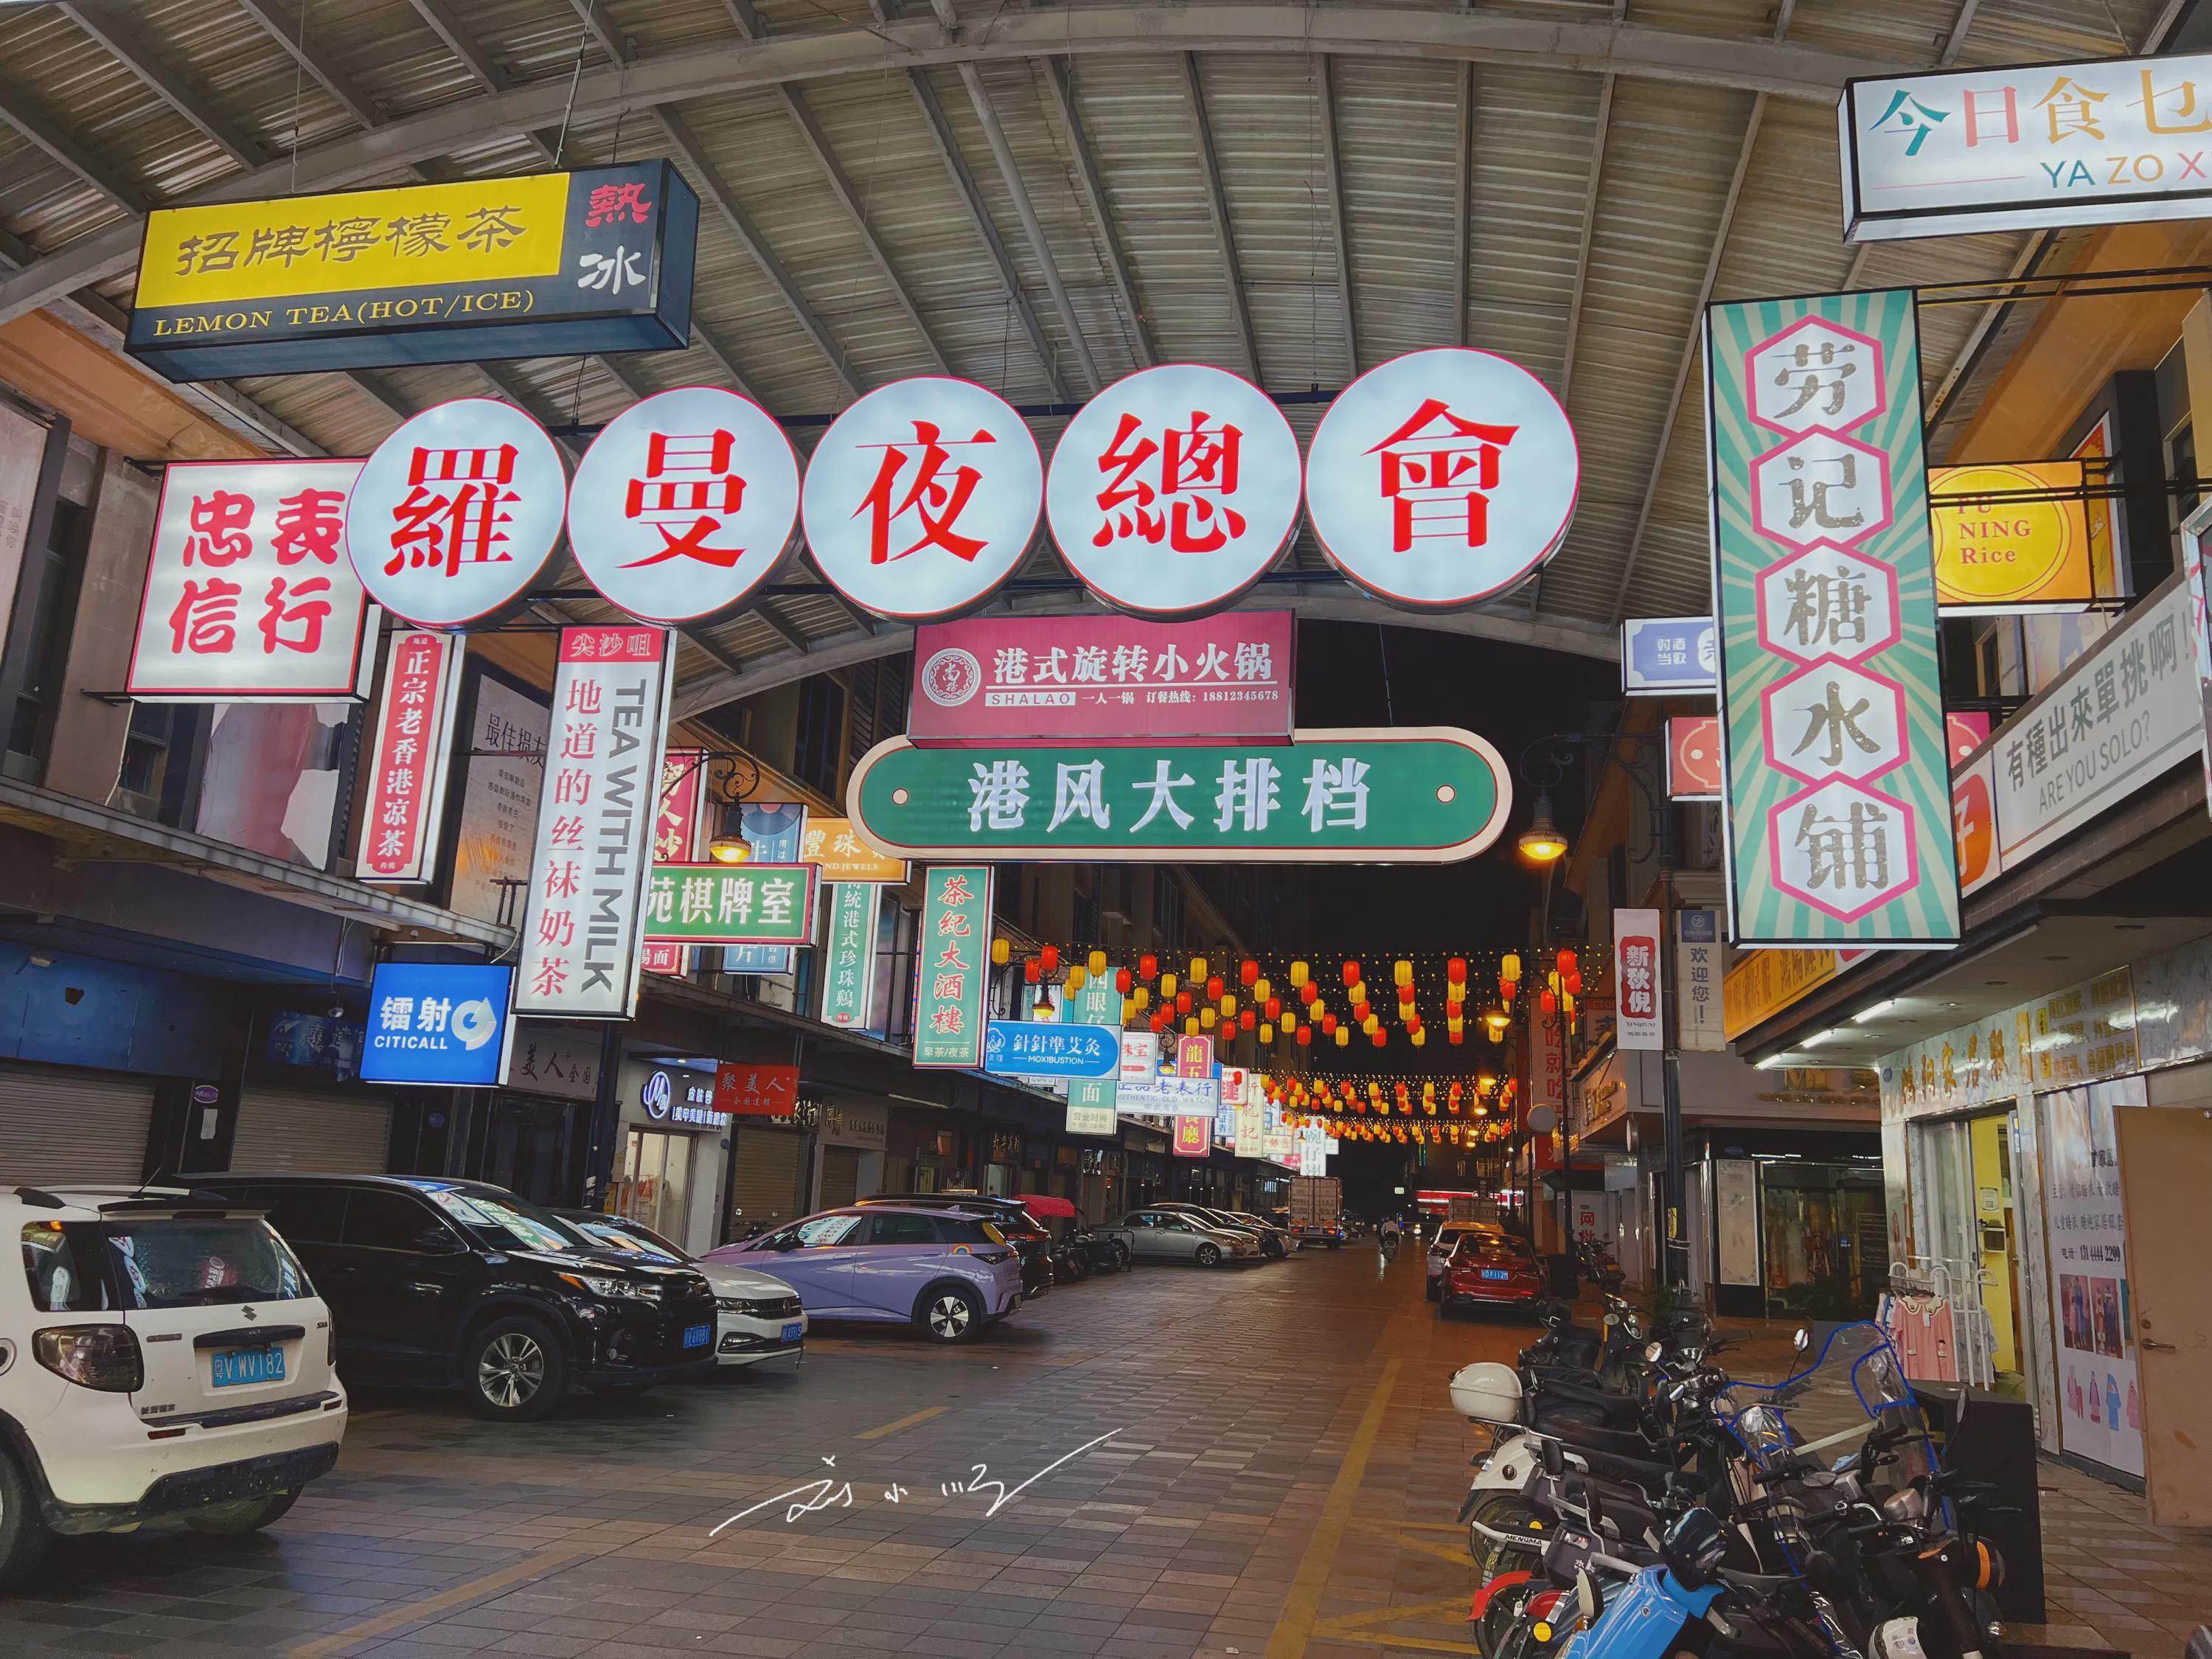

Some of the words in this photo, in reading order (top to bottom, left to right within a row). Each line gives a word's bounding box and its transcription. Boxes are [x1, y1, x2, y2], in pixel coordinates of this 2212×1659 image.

[1869, 69, 2212, 156] 今日食乜
[2177, 150, 2212, 181] X
[174, 206, 528, 277] 招牌檸檬茶
[153, 310, 272, 336] LEMON
[286, 290, 535, 325] TEA(HOT/ICE)
[383, 397, 1522, 577] 羅曼夜總會
[1958, 519, 2031, 540] NING
[1960, 546, 2017, 565] Rice
[569, 632, 652, 658] 尖沙咀
[993, 641, 1272, 685] 港式旋转小火锅
[608, 678, 647, 759] TEA
[991, 693, 1071, 706] SHALAO
[1082, 691, 1135, 705] 一人一锅
[377, 649, 432, 858] 正宗老香港凉茶
[2039, 779, 2065, 814] ARE
[2065, 757, 2097, 795] YOU
[2100, 709, 2151, 776] SOLO?
[967, 757, 1371, 833] 港风大排档
[529, 678, 602, 998] 地道的丝袜奶茶
[597, 764, 638, 877] WITH
[647, 876, 795, 925] 苑棋牌室
[580, 887, 623, 995] MILK
[929, 874, 975, 1034] 茶紀大酒樓
[380, 995, 452, 1032] 镭射
[373, 1034, 448, 1050] CITICALL
[1013, 1033, 1101, 1057] 針針準艾灸
[1028, 1055, 1084, 1065] MOXIBUSTION
[1162, 1095, 1178, 1103] OLD
[1183, 1096, 1211, 1104] WATCH
[2104, 1245, 2121, 1262] 2299
[1504, 1534, 1543, 1546] MENGMA
